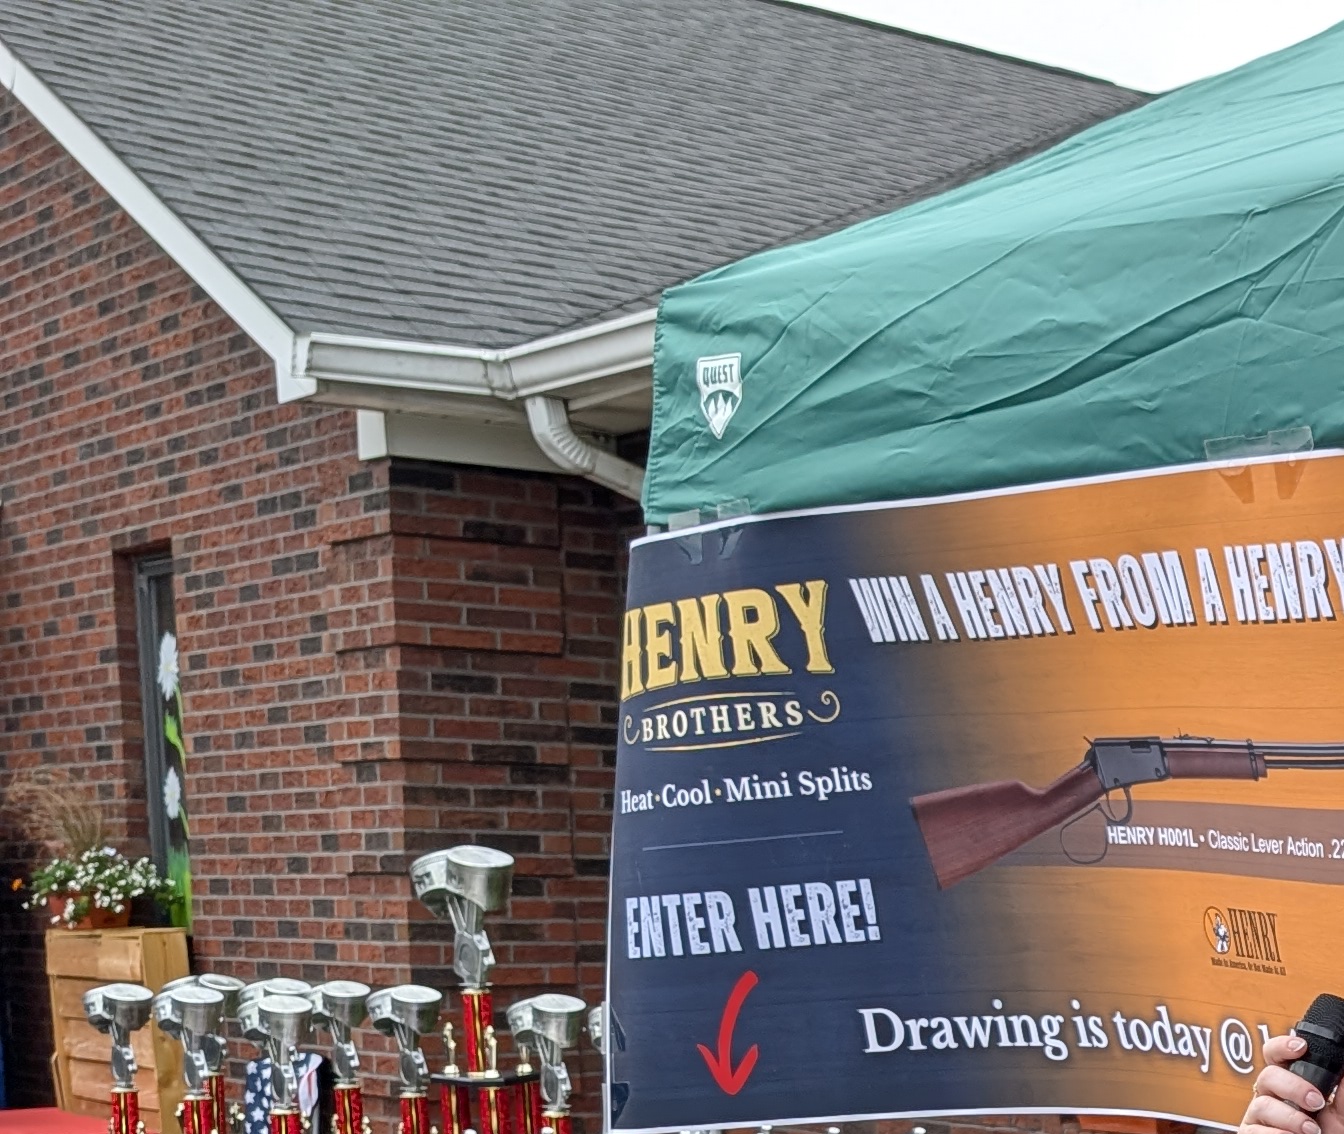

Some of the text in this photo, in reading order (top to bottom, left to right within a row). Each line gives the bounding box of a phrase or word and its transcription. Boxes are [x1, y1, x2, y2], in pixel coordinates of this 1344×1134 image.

[703, 364, 734, 388] QUEST
[849, 575, 930, 643] WIN
[920, 574, 960, 640] A
[946, 563, 1073, 640] HENRY
[1069, 550, 1195, 631] FROM
[1195, 548, 1228, 623] A
[621, 579, 836, 702] HENRY
[641, 700, 804, 743] BROTHERS
[798, 766, 873, 801] Splits
[1107, 825, 1155, 846] HENRY
[1207, 829, 1249, 852] Classic
[1251, 833, 1285, 855] Lever
[1287, 836, 1325, 859] Action
[625, 878, 881, 959] ENTER HERE!
[1227, 907, 1282, 963] HENRY
[858, 998, 1254, 1075] Drawing is today @
